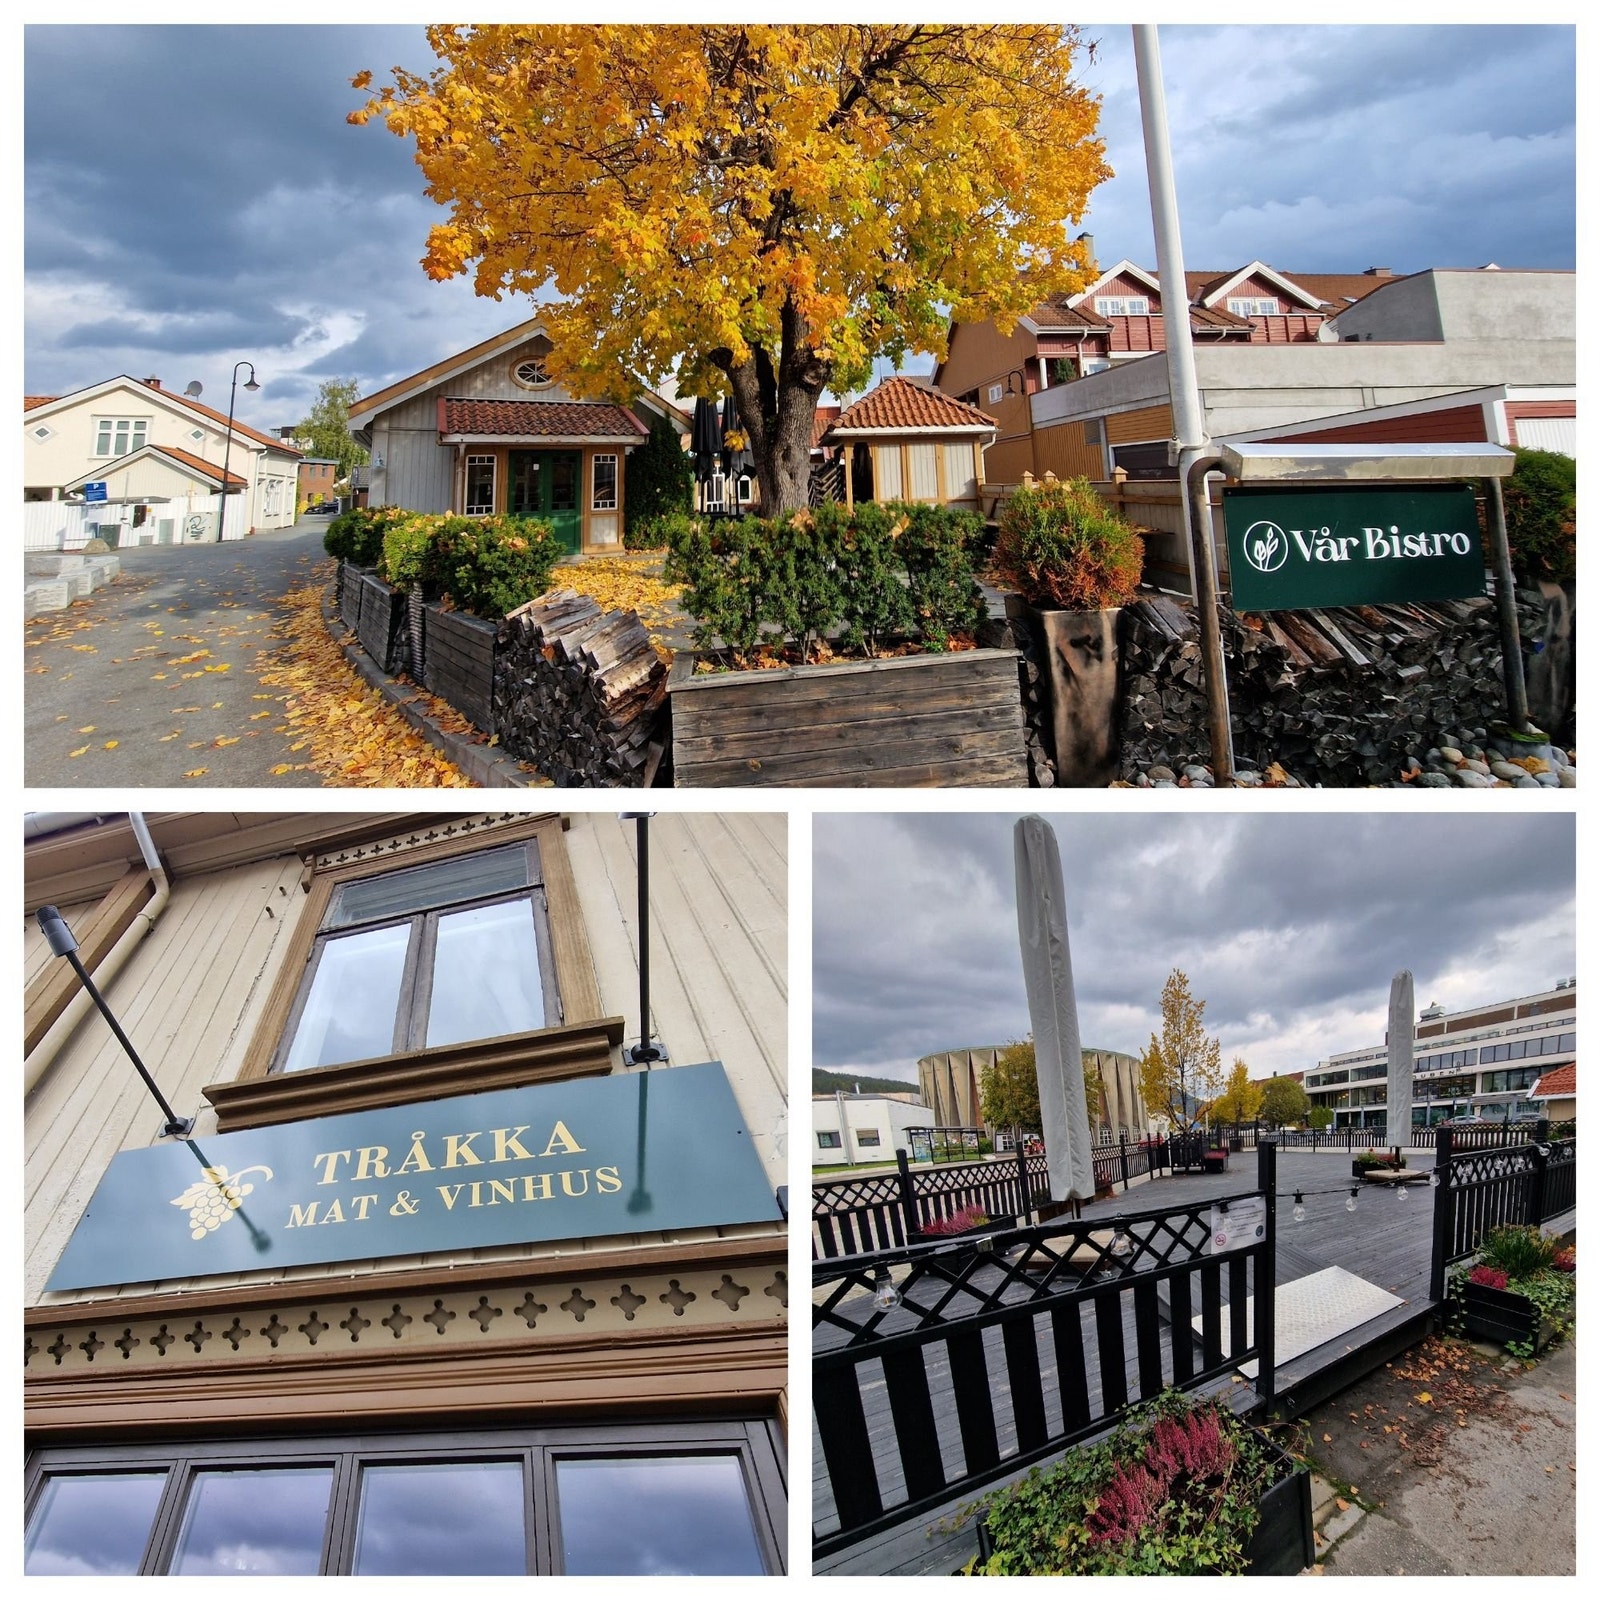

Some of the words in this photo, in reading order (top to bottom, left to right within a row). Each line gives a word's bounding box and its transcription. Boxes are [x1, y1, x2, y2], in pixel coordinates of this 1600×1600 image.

[1289, 526, 1360, 562] Vår
[1362, 525, 1471, 560] Bistro
[313, 1120, 587, 1186] TRÅKKA
[284, 1193, 378, 1229] MAT
[389, 1190, 420, 1216] &
[435, 1165, 623, 1211] VINHUS
